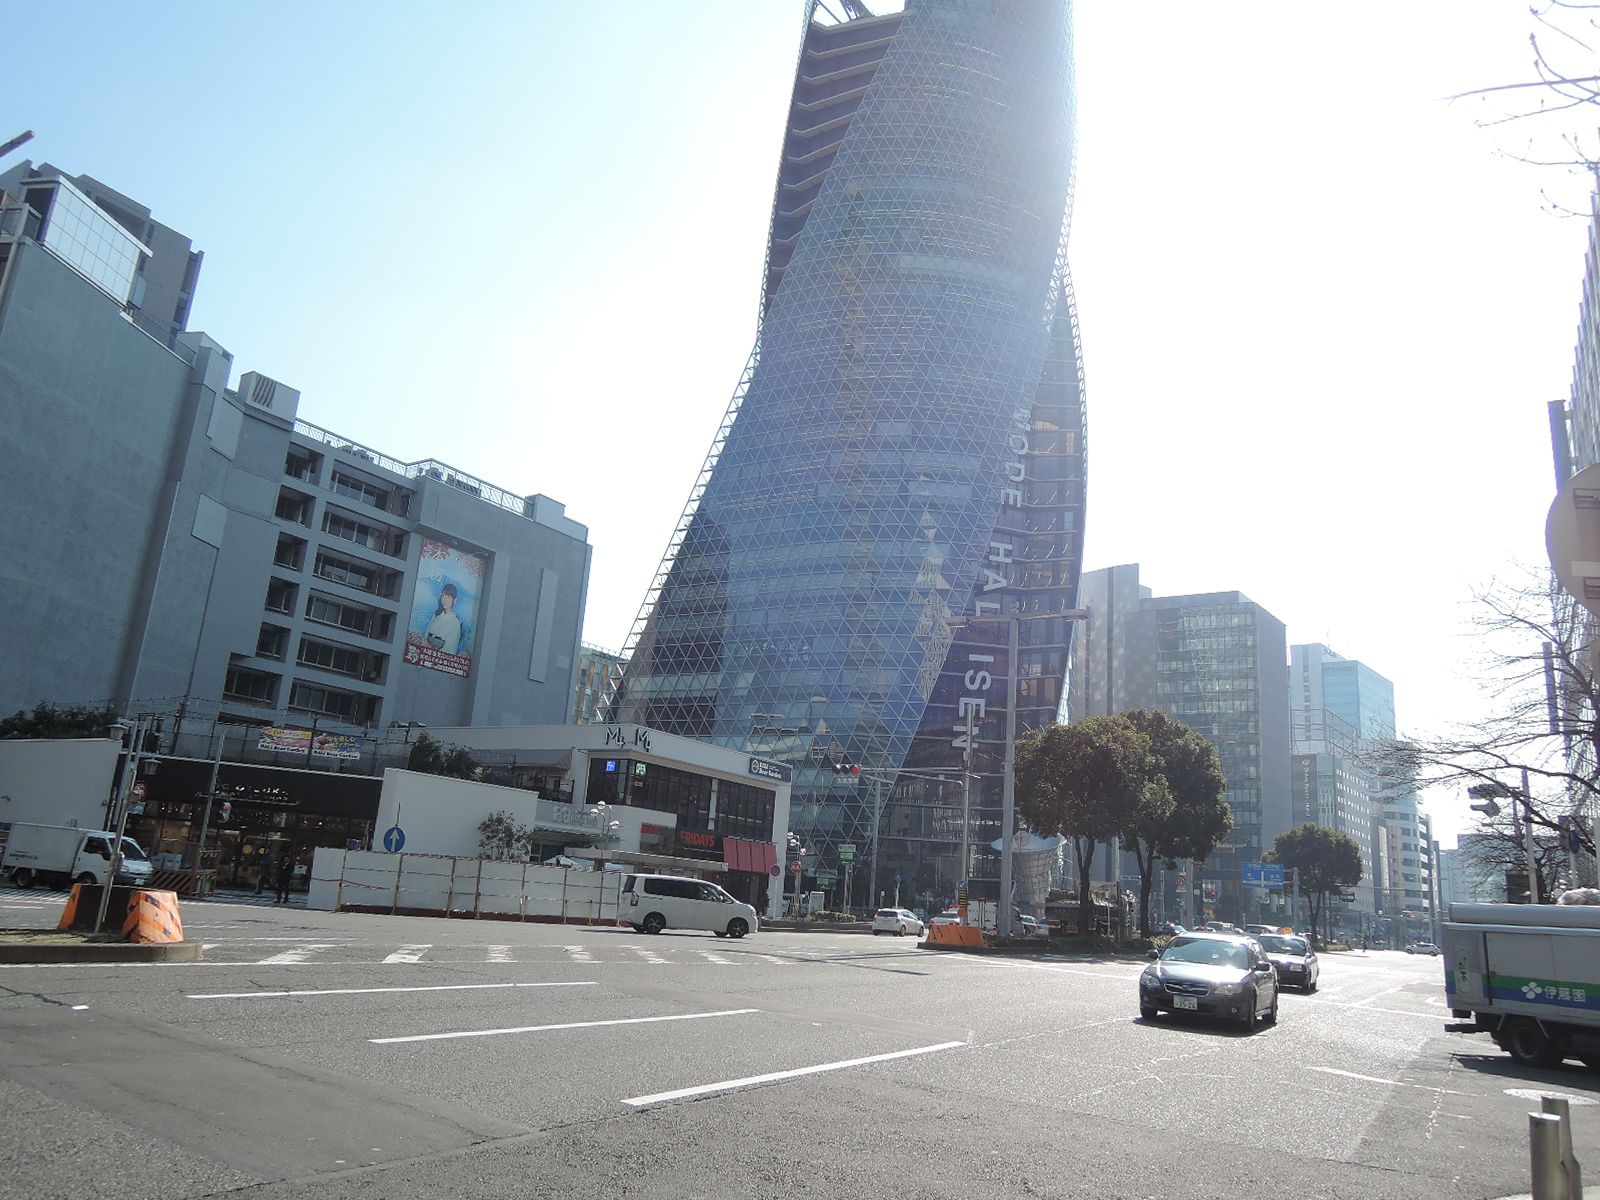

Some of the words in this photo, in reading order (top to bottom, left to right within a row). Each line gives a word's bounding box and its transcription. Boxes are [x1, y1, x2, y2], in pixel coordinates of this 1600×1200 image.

[1001, 406, 1031, 508] MODE
[976, 541, 1012, 617] HAL
[951, 654, 994, 749] ISEN
[680, 830, 716, 847] FRIDAYS
